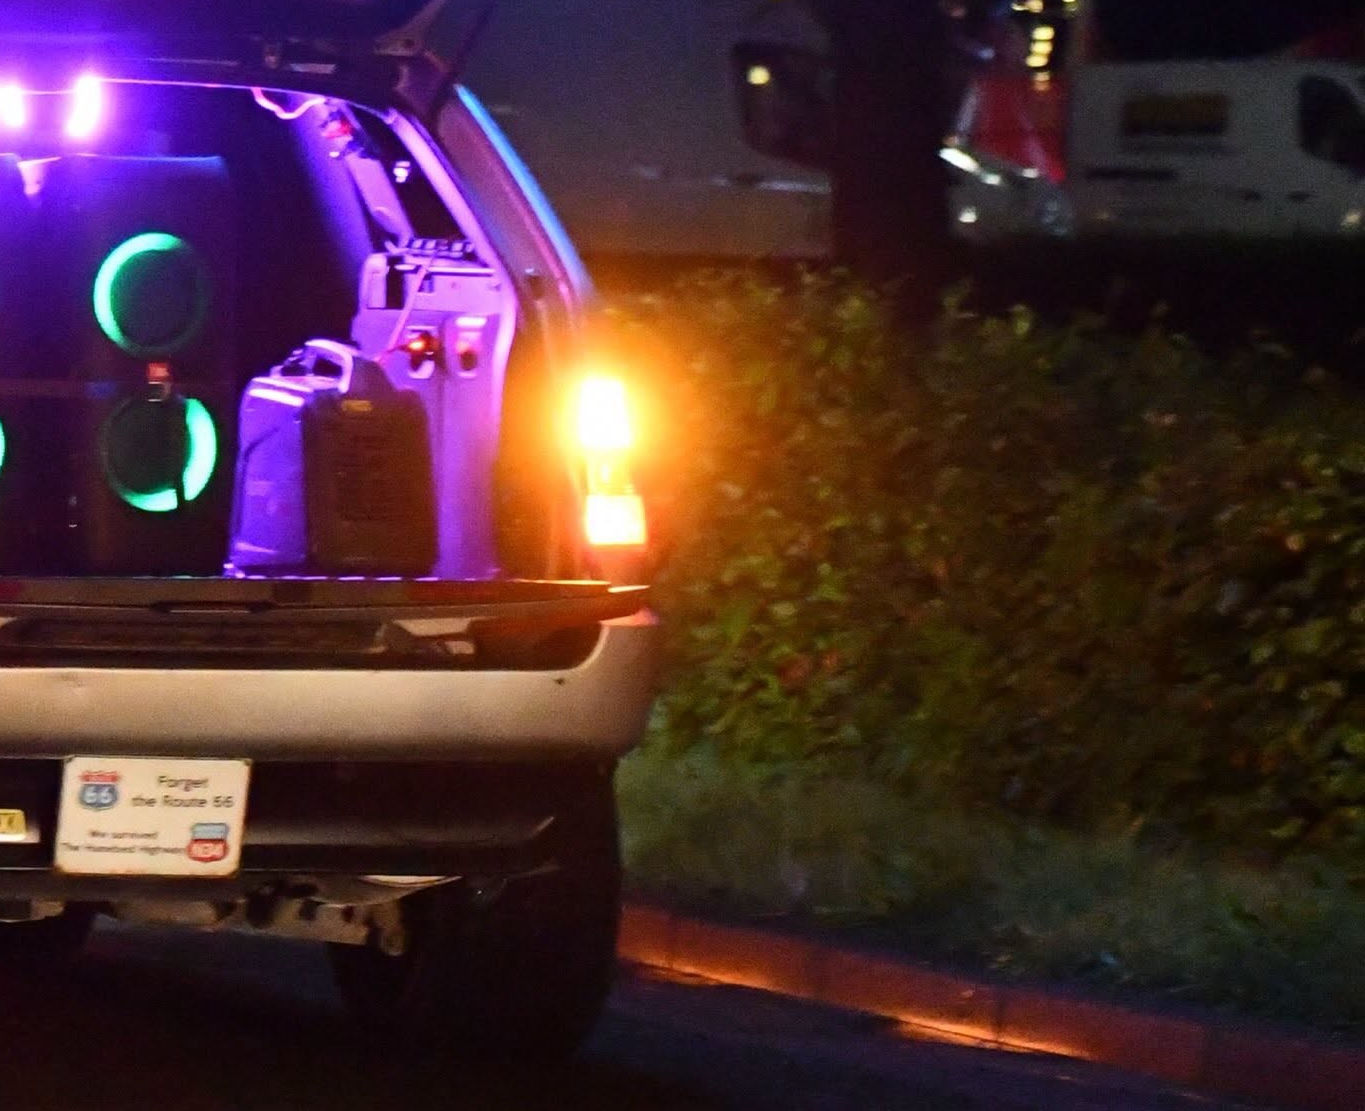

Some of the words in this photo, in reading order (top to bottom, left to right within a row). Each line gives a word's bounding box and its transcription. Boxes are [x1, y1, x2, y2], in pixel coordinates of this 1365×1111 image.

[157, 775, 209, 792] Forget
[83, 786, 114, 804] 66
[131, 794, 157, 808] the
[162, 794, 208, 808] Route
[213, 795, 235, 808] 66
